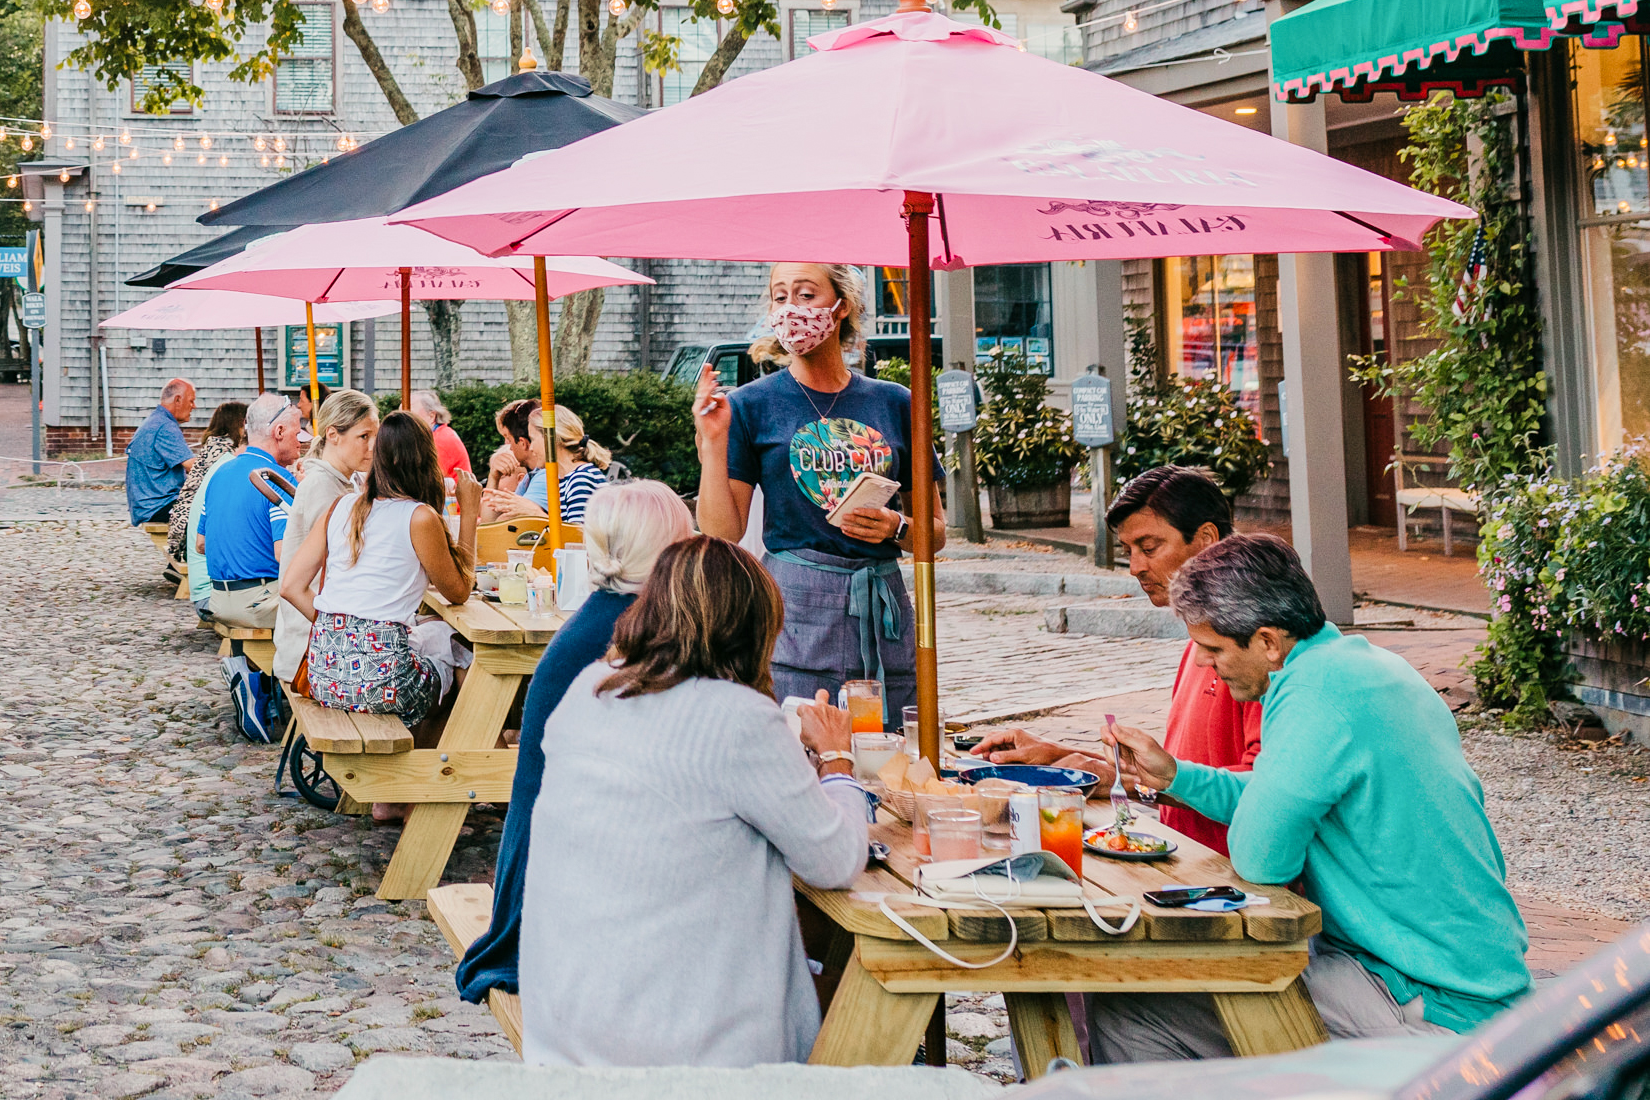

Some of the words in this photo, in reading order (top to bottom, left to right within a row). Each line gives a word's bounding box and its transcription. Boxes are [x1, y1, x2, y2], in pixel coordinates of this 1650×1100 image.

[945, 403, 967, 414] ONLY
[1079, 413, 1103, 425] ONLY
[798, 447, 845, 473] CLUB
[850, 449, 885, 473] CAR
